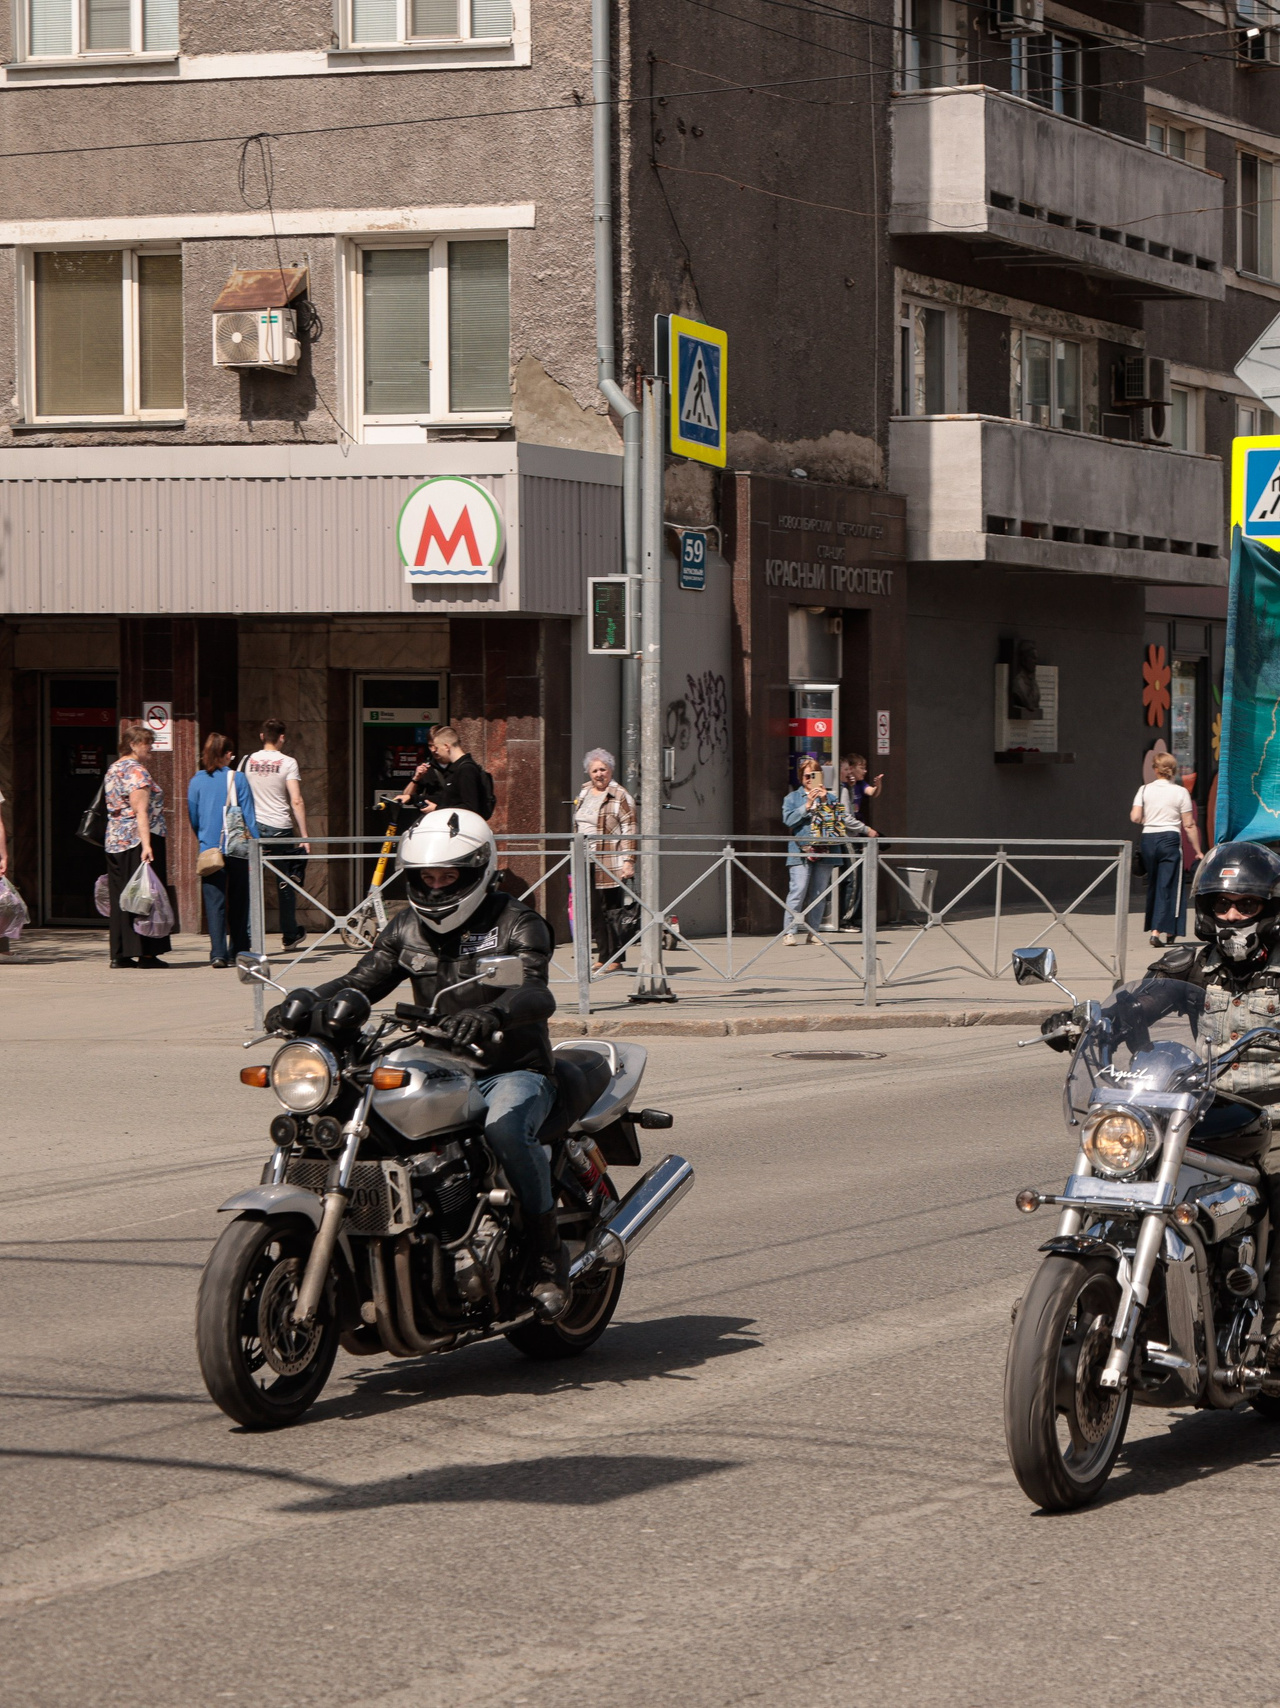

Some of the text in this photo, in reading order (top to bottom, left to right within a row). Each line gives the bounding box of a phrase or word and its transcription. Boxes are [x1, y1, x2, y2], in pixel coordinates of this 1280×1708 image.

[684, 539, 704, 563] 59
[765, 559, 894, 595] КРАСНЫЙ ПРОСПЕКТ
